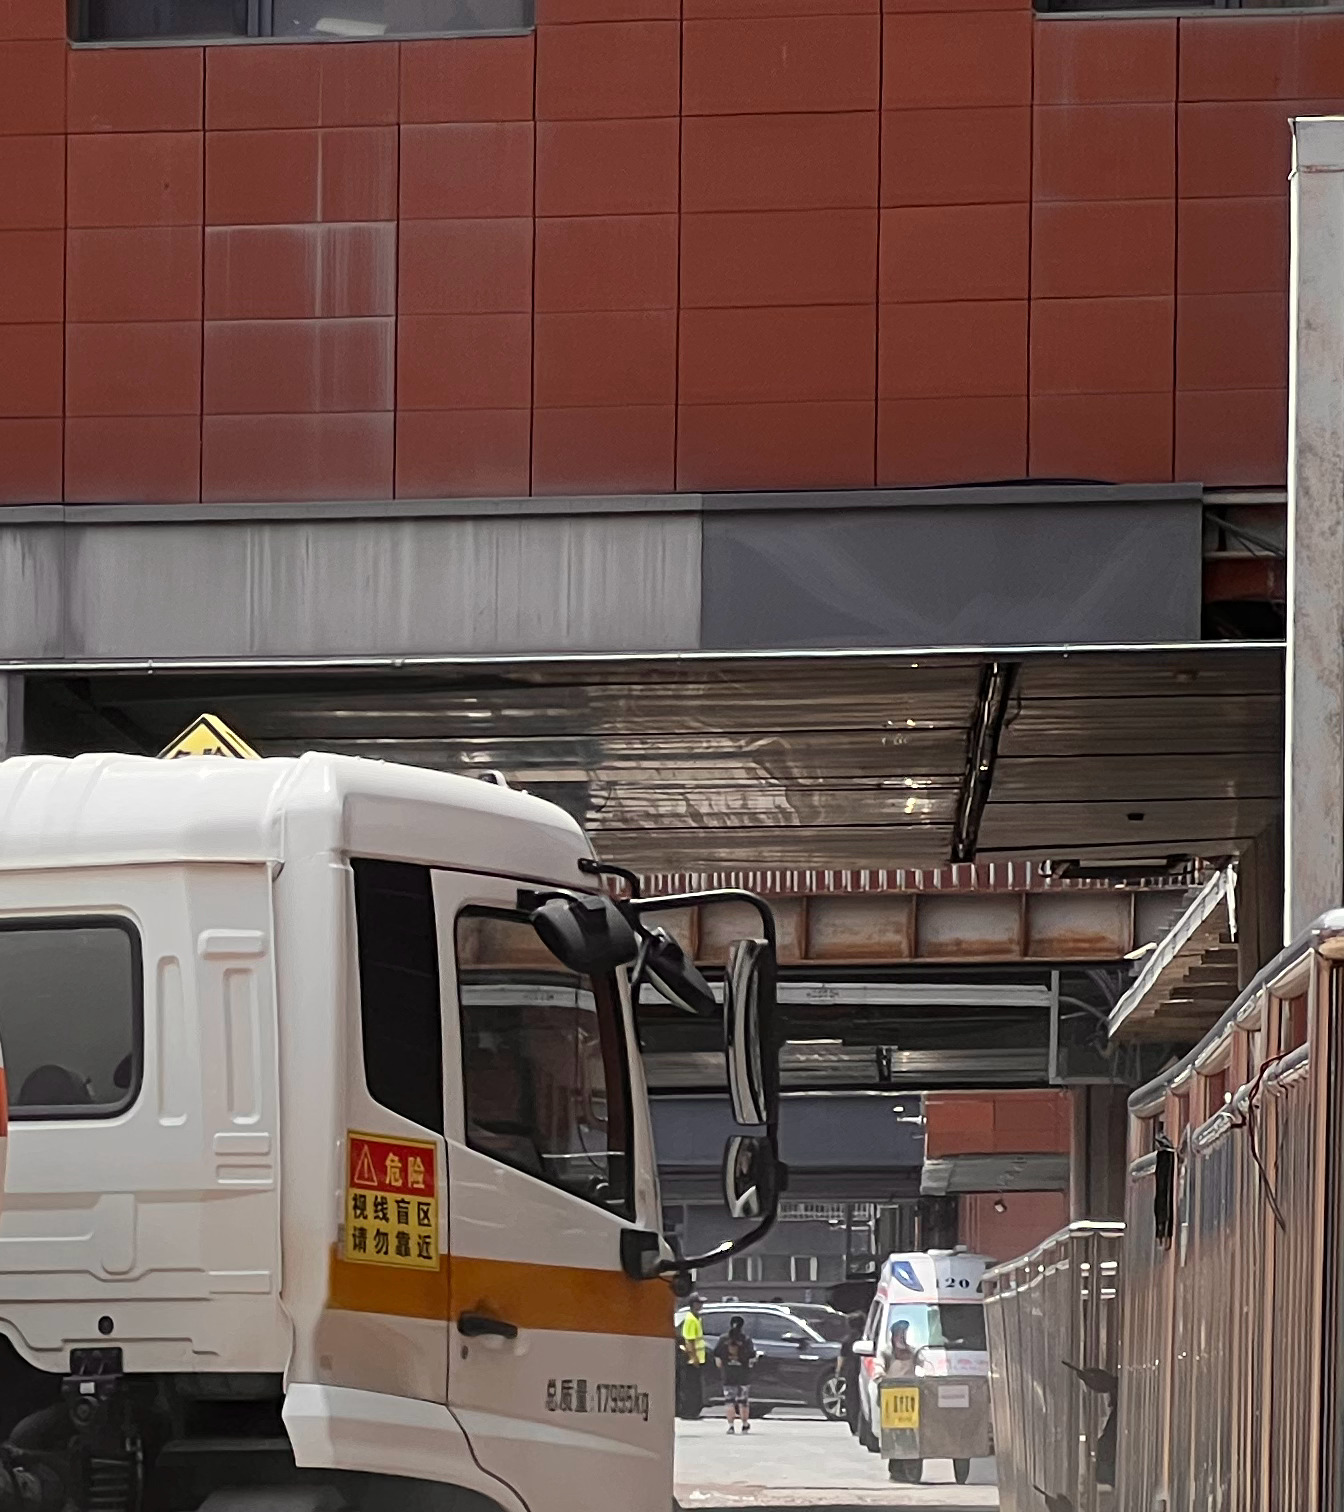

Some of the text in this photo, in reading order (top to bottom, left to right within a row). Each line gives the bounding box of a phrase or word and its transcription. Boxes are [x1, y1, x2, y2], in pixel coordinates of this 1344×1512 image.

[385, 1152, 425, 1190] 危险
[352, 1193, 432, 1227] 视线盲区
[352, 1226, 433, 1260] 请勿靠近
